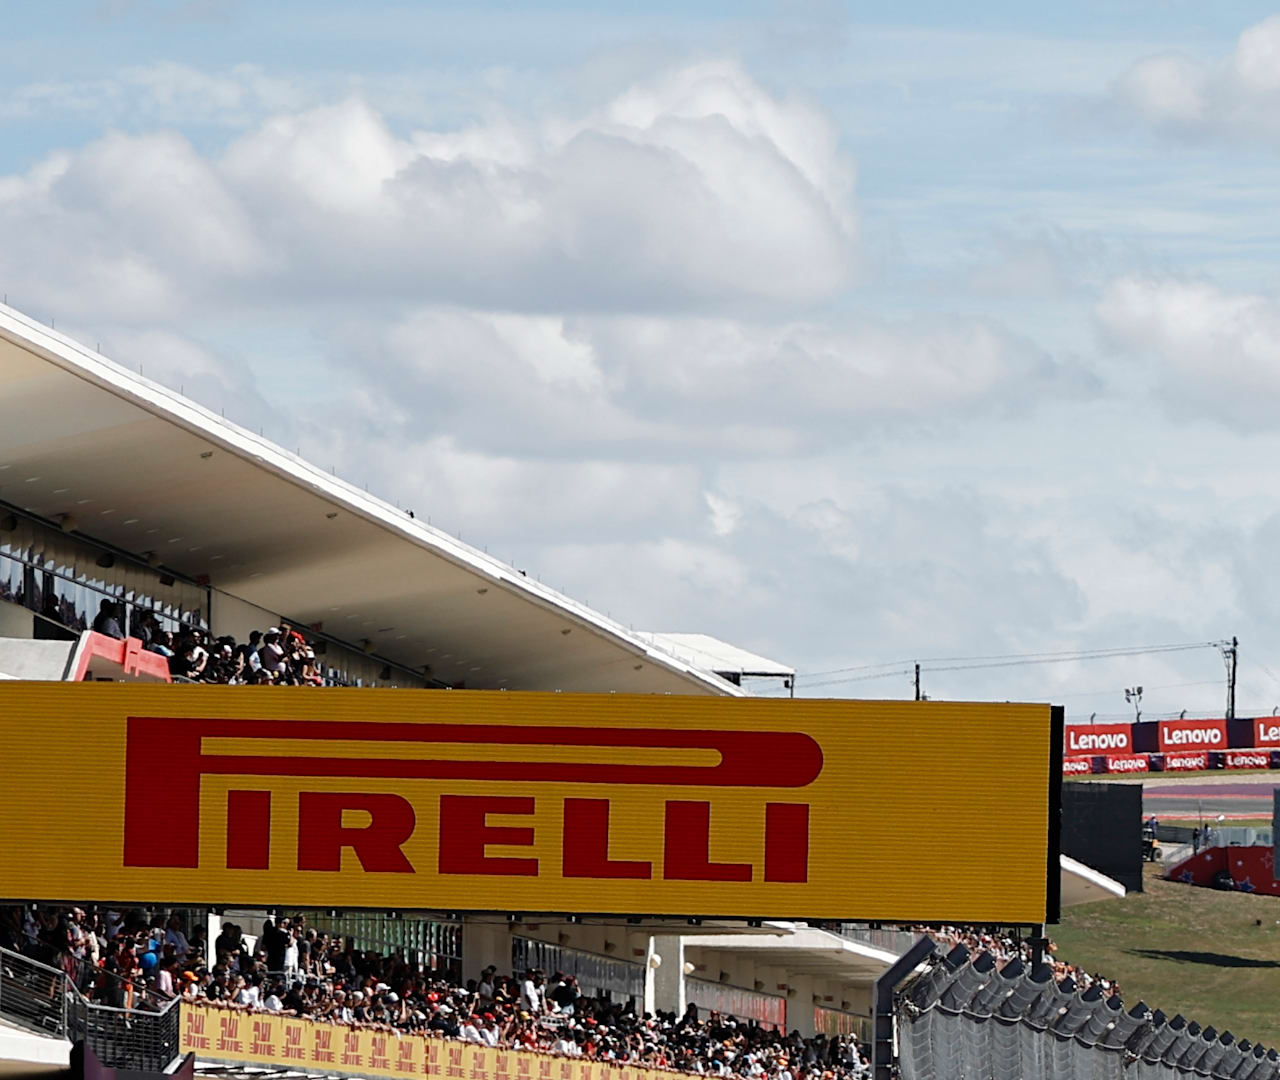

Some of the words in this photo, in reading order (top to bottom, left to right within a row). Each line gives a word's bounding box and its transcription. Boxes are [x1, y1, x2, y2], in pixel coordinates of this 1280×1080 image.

[1070, 731, 1128, 750] Lenovo
[1163, 727, 1221, 745] Lenovo
[1063, 761, 1089, 773] novo
[1108, 756, 1147, 770] Lenovo
[1227, 754, 1267, 768] Lenovo
[124, 716, 824, 884] PIRELLI
